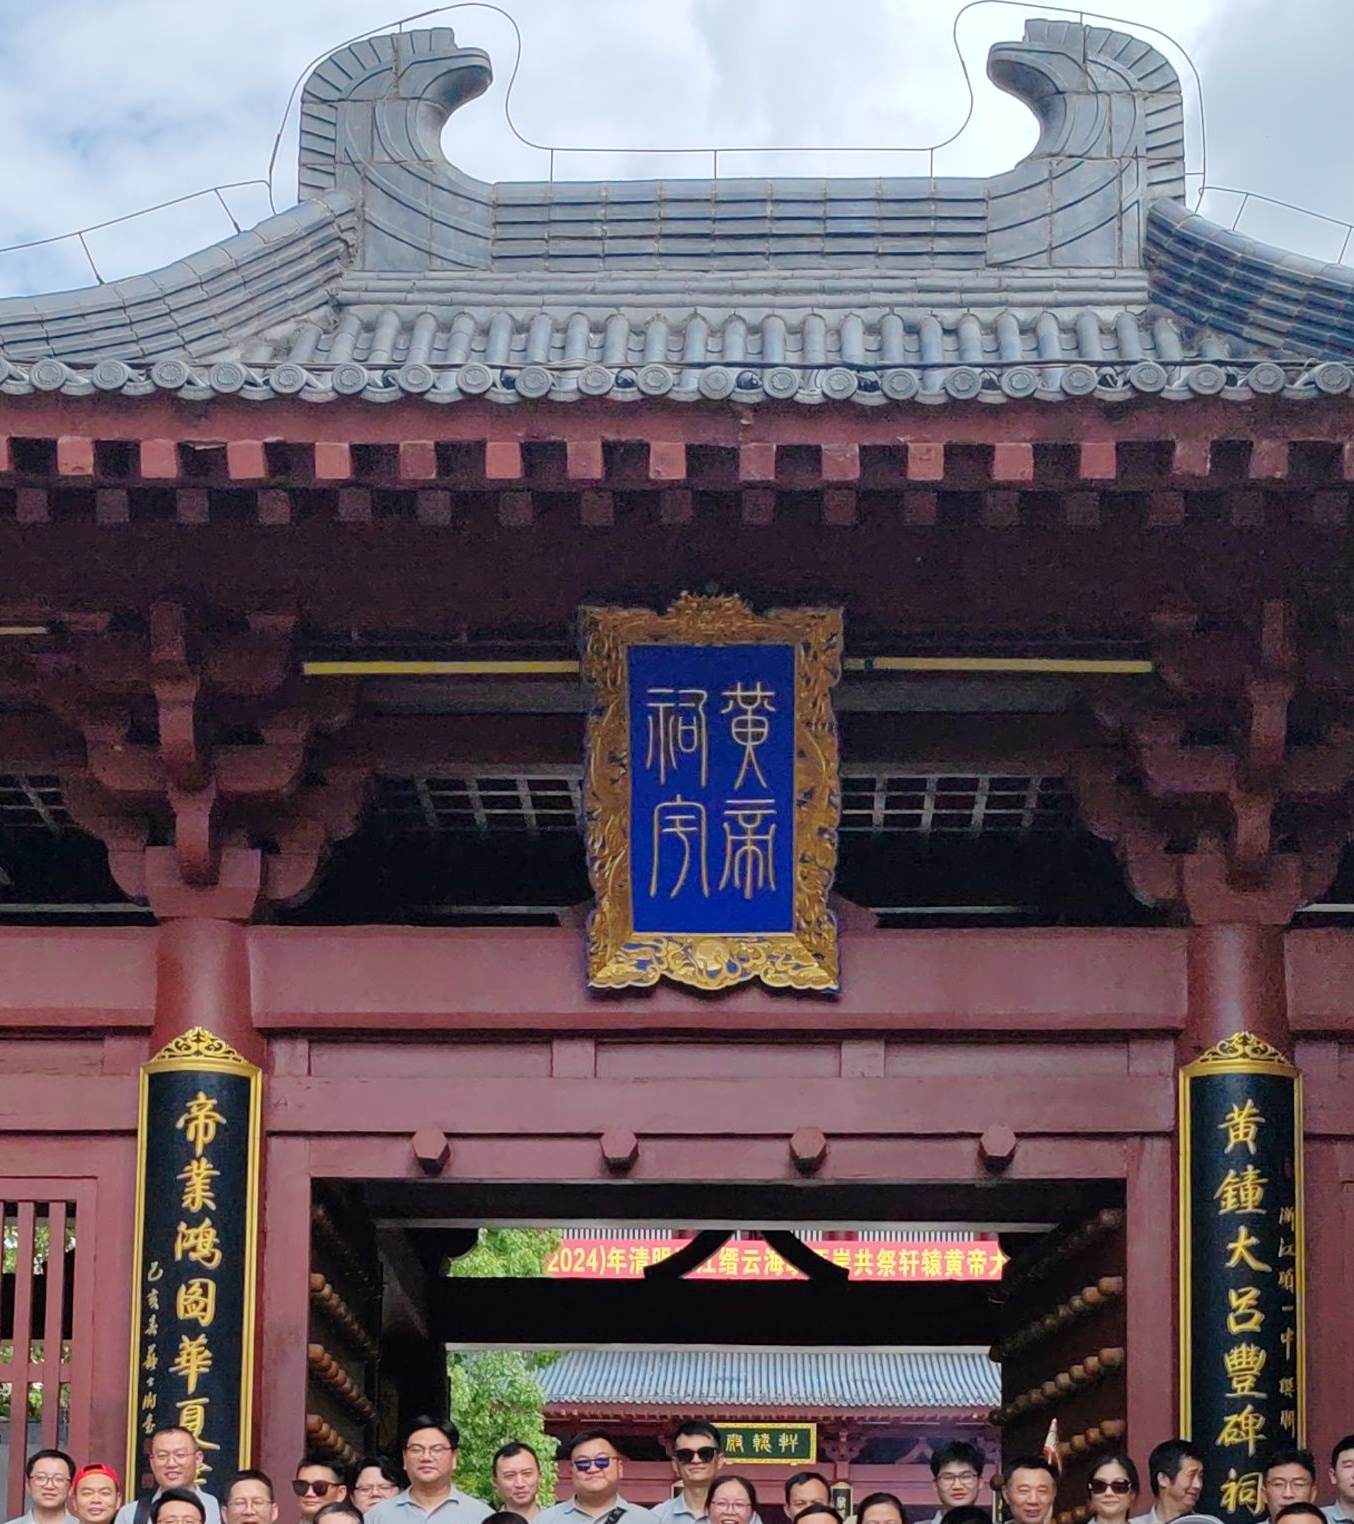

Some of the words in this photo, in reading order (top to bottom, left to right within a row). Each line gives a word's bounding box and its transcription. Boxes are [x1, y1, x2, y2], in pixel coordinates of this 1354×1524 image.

[169, 1091, 225, 1484] 帝業鴻圖華夏
